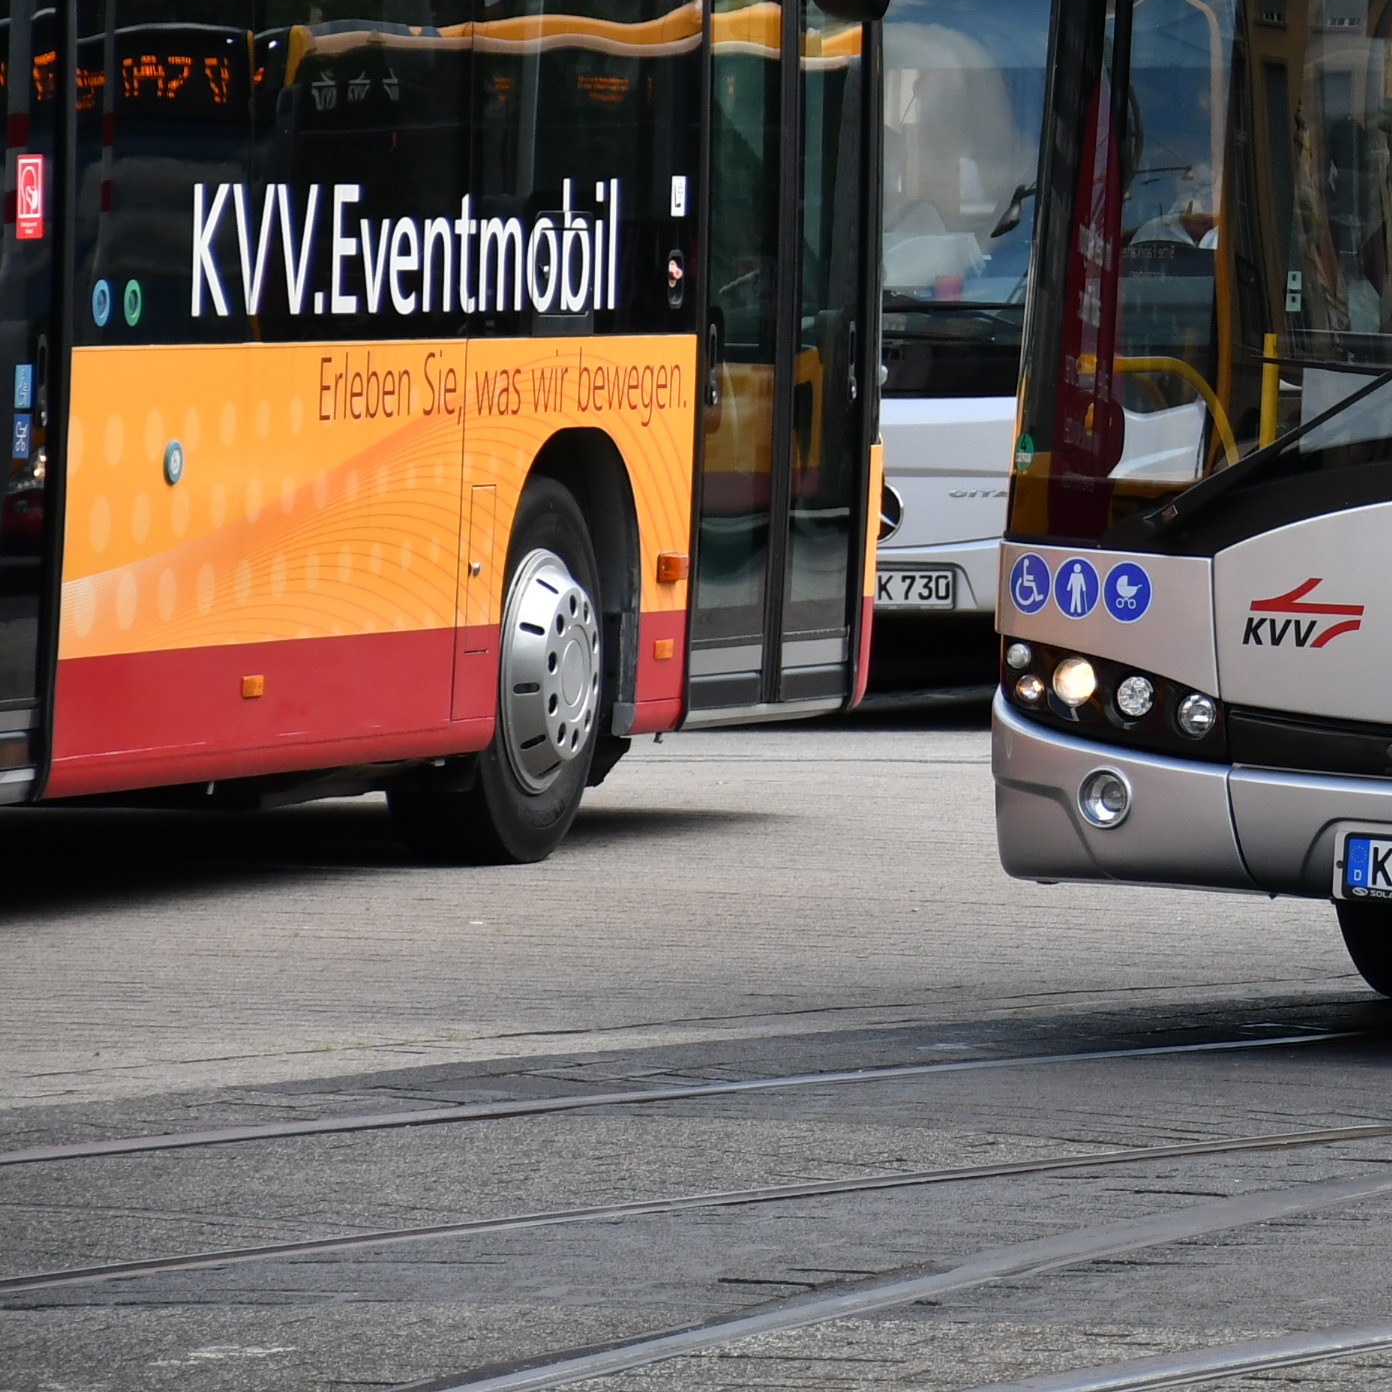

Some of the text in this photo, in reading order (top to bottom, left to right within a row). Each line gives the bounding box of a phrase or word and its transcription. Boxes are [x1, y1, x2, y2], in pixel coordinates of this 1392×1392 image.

[191, 177, 619, 317] KVV.Eventmobil
[318, 347, 688, 427] Erleben Sie, was wir bewegen.
[1019, 434, 1027, 452] 4
[948, 489, 1008, 499] CITA
[901, 574, 951, 601] 730
[1242, 617, 1317, 648] KVV
[1353, 869, 1362, 881] D
